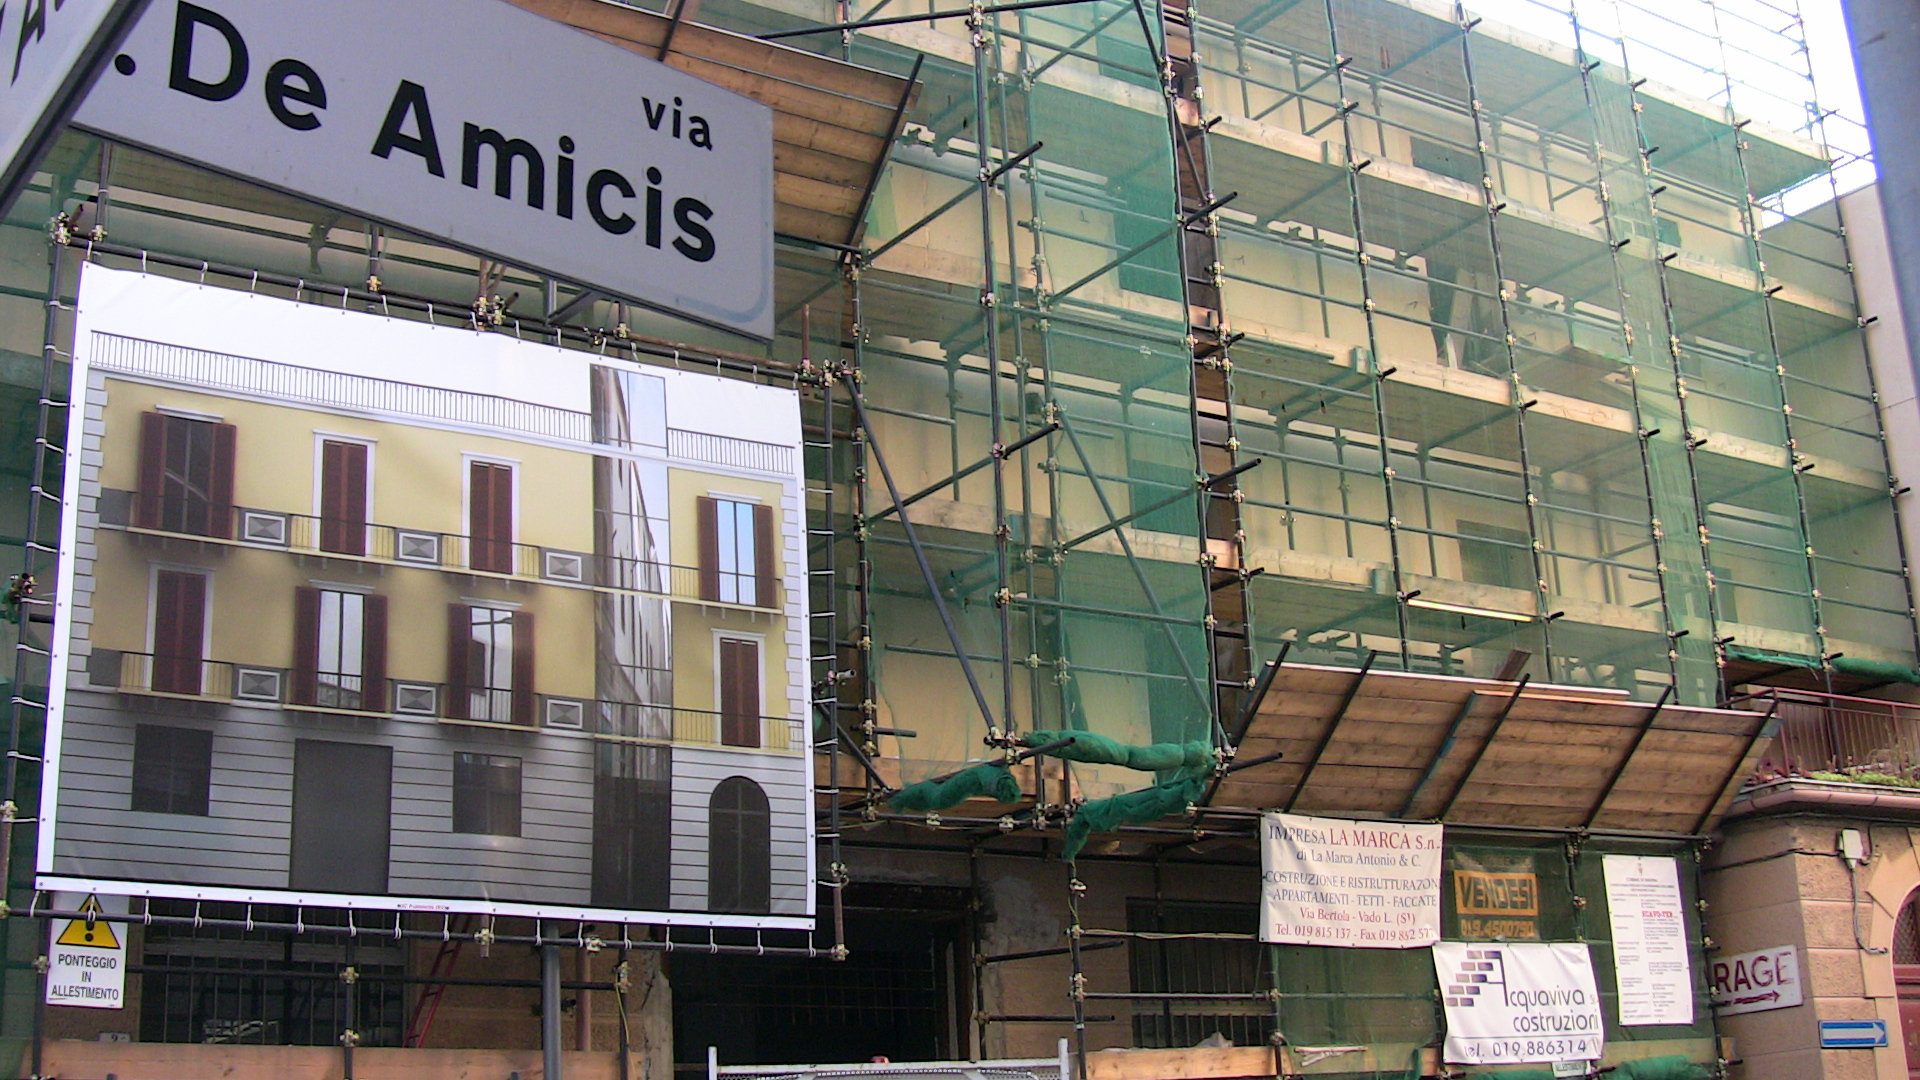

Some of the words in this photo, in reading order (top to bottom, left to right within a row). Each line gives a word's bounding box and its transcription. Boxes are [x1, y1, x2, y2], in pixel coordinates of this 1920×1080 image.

[642, 95, 713, 152] via
[370, 79, 716, 263] Amicis
[1269, 825, 1327, 844] IMPRESA
[1329, 828, 1349, 847] LA
[1352, 830, 1411, 850] MARCA
[1296, 850, 1307, 861] di
[1311, 850, 1323, 863] La
[1326, 851, 1353, 864] Marca
[1356, 852, 1396, 866] Antonio
[1399, 855, 1409, 867] &
[1265, 870, 1338, 887] COSTRUZIONE
[1273, 888, 1350, 906] APPARTAMENTI
[1356, 893, 1385, 906] TETTI
[1393, 894, 1437, 908] FACCATE
[1458, 876, 1534, 910] VENDESI
[1300, 907, 1315, 919] Via
[1294, 925, 1313, 937] 019
[1315, 926, 1332, 938] 815
[1335, 928, 1351, 939] 137
[1360, 929, 1376, 941] Fax
[1379, 930, 1396, 941] 019
[58, 953, 117, 970] PONTEGGIO
[82, 971, 92, 983] IN
[1713, 951, 1795, 994] RAGE
[51, 984, 119, 1000] ALLESTIMENTO
